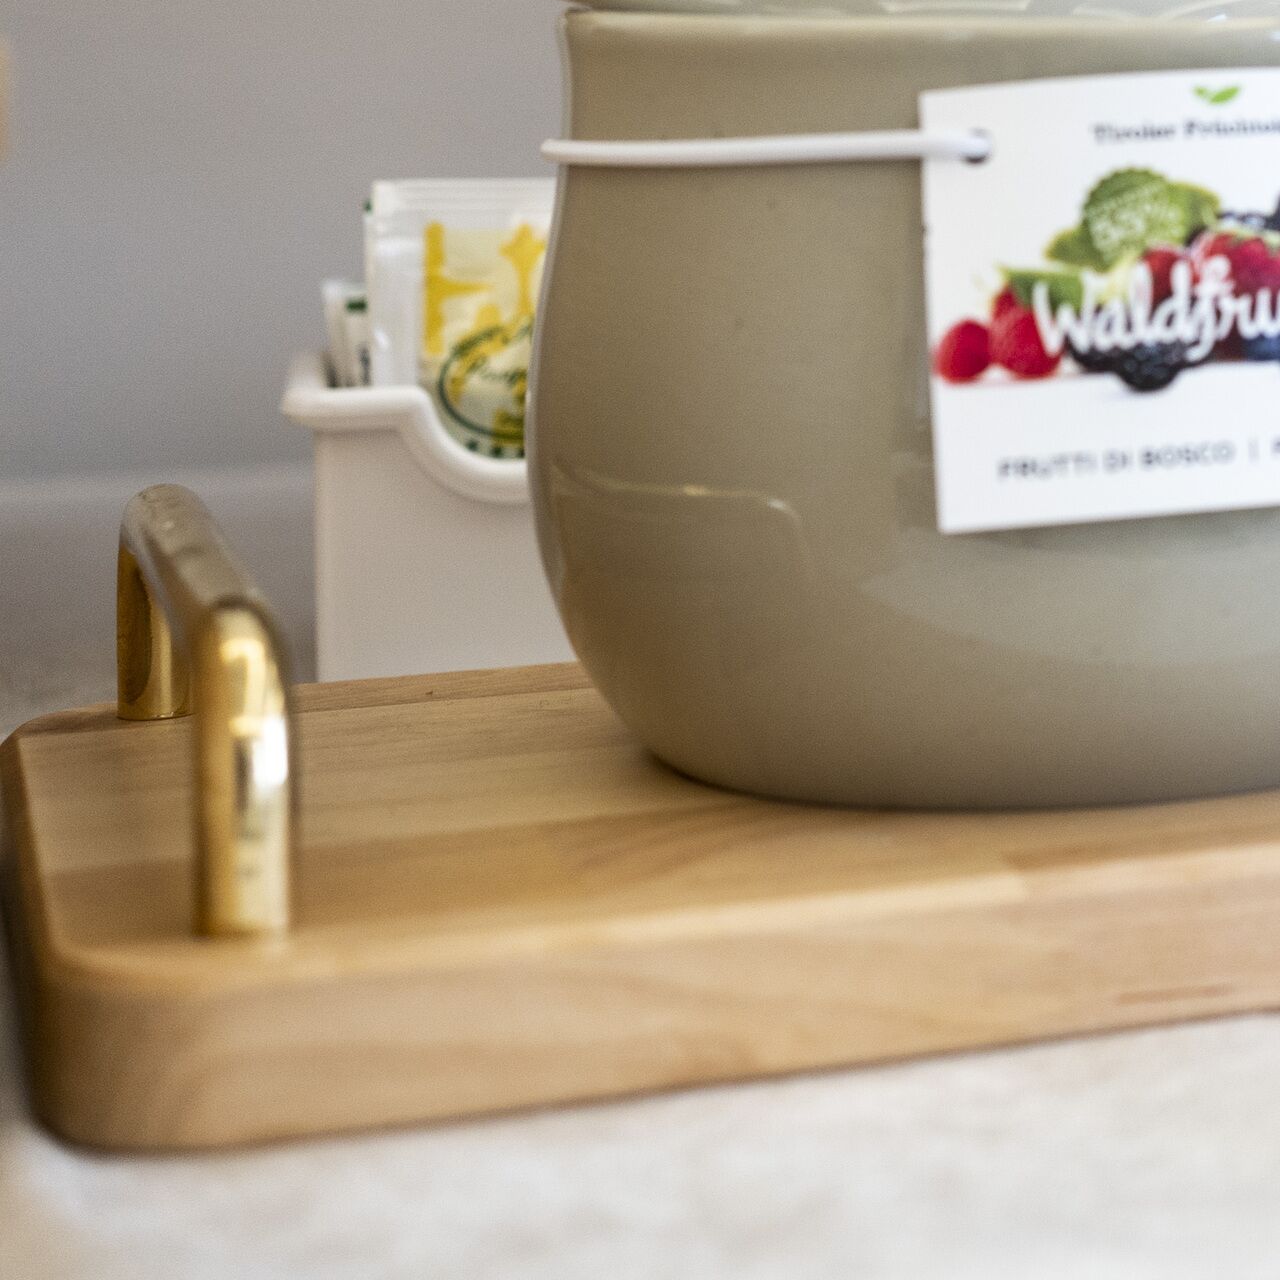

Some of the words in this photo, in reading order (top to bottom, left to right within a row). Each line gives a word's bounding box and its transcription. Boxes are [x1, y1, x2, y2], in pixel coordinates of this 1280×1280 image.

[998, 449, 1098, 480] FRUTTI
[1102, 447, 1131, 473] DI
[1138, 440, 1237, 471] BOSCO
